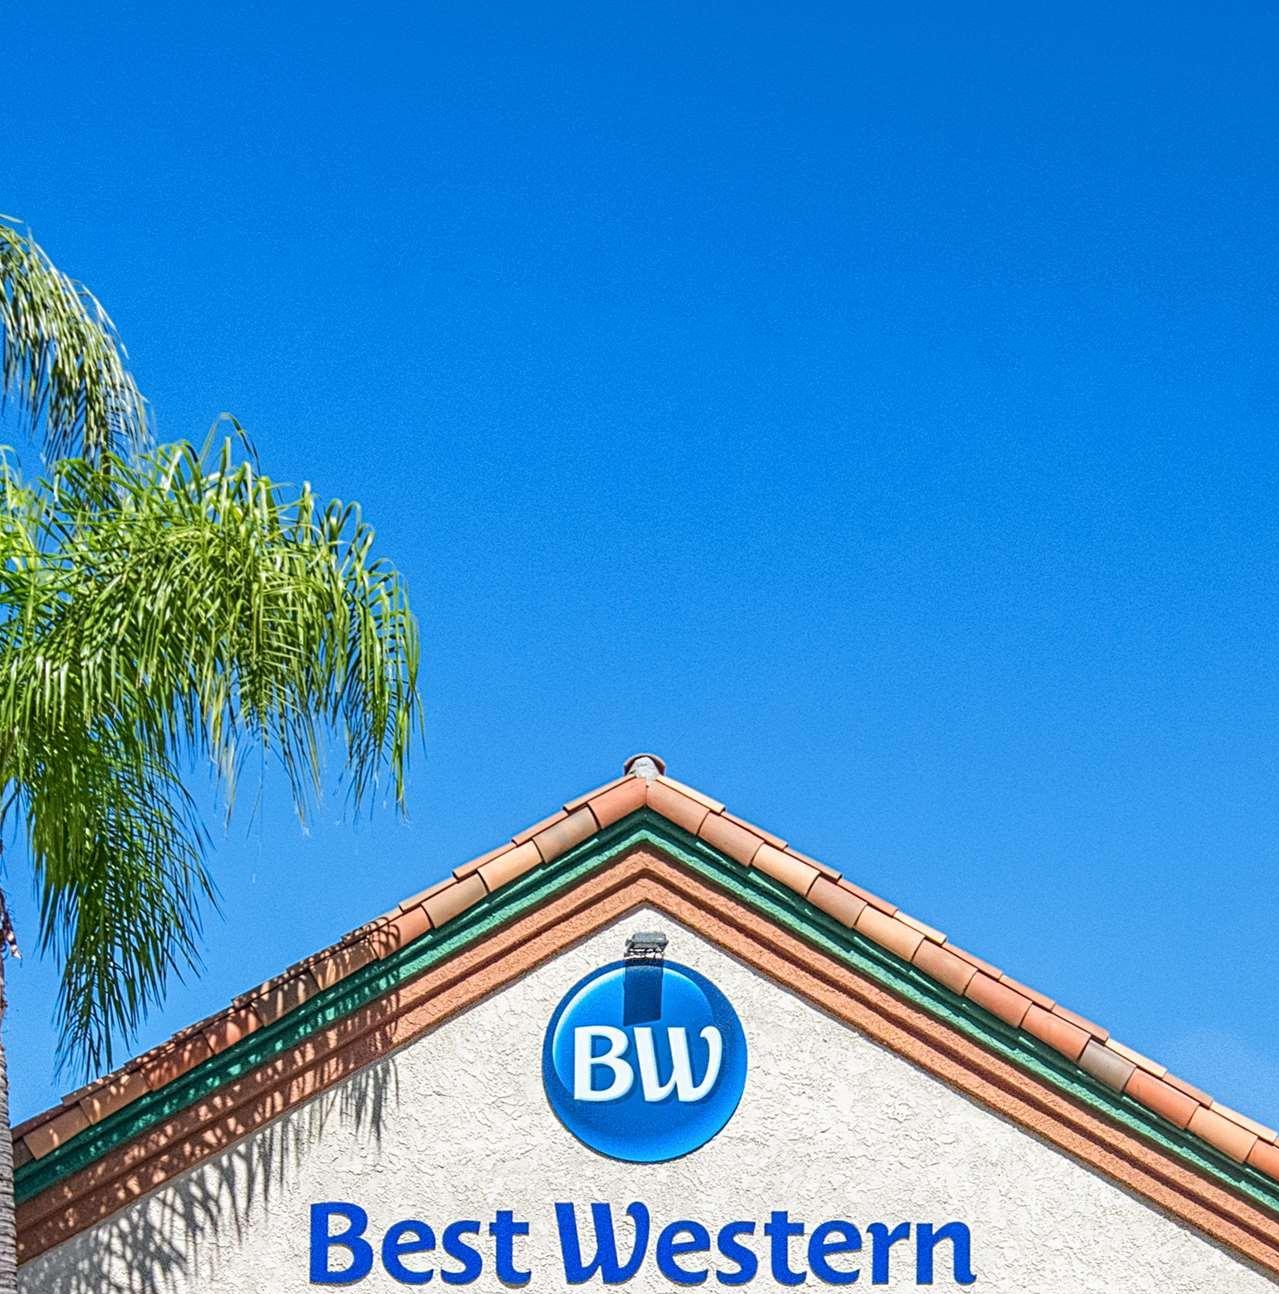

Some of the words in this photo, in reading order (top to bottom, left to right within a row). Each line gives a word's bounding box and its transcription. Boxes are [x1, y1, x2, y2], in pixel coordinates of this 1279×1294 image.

[573, 1025, 722, 1102] BW
[309, 1201, 531, 1285] Best
[554, 1201, 977, 1286] Western
